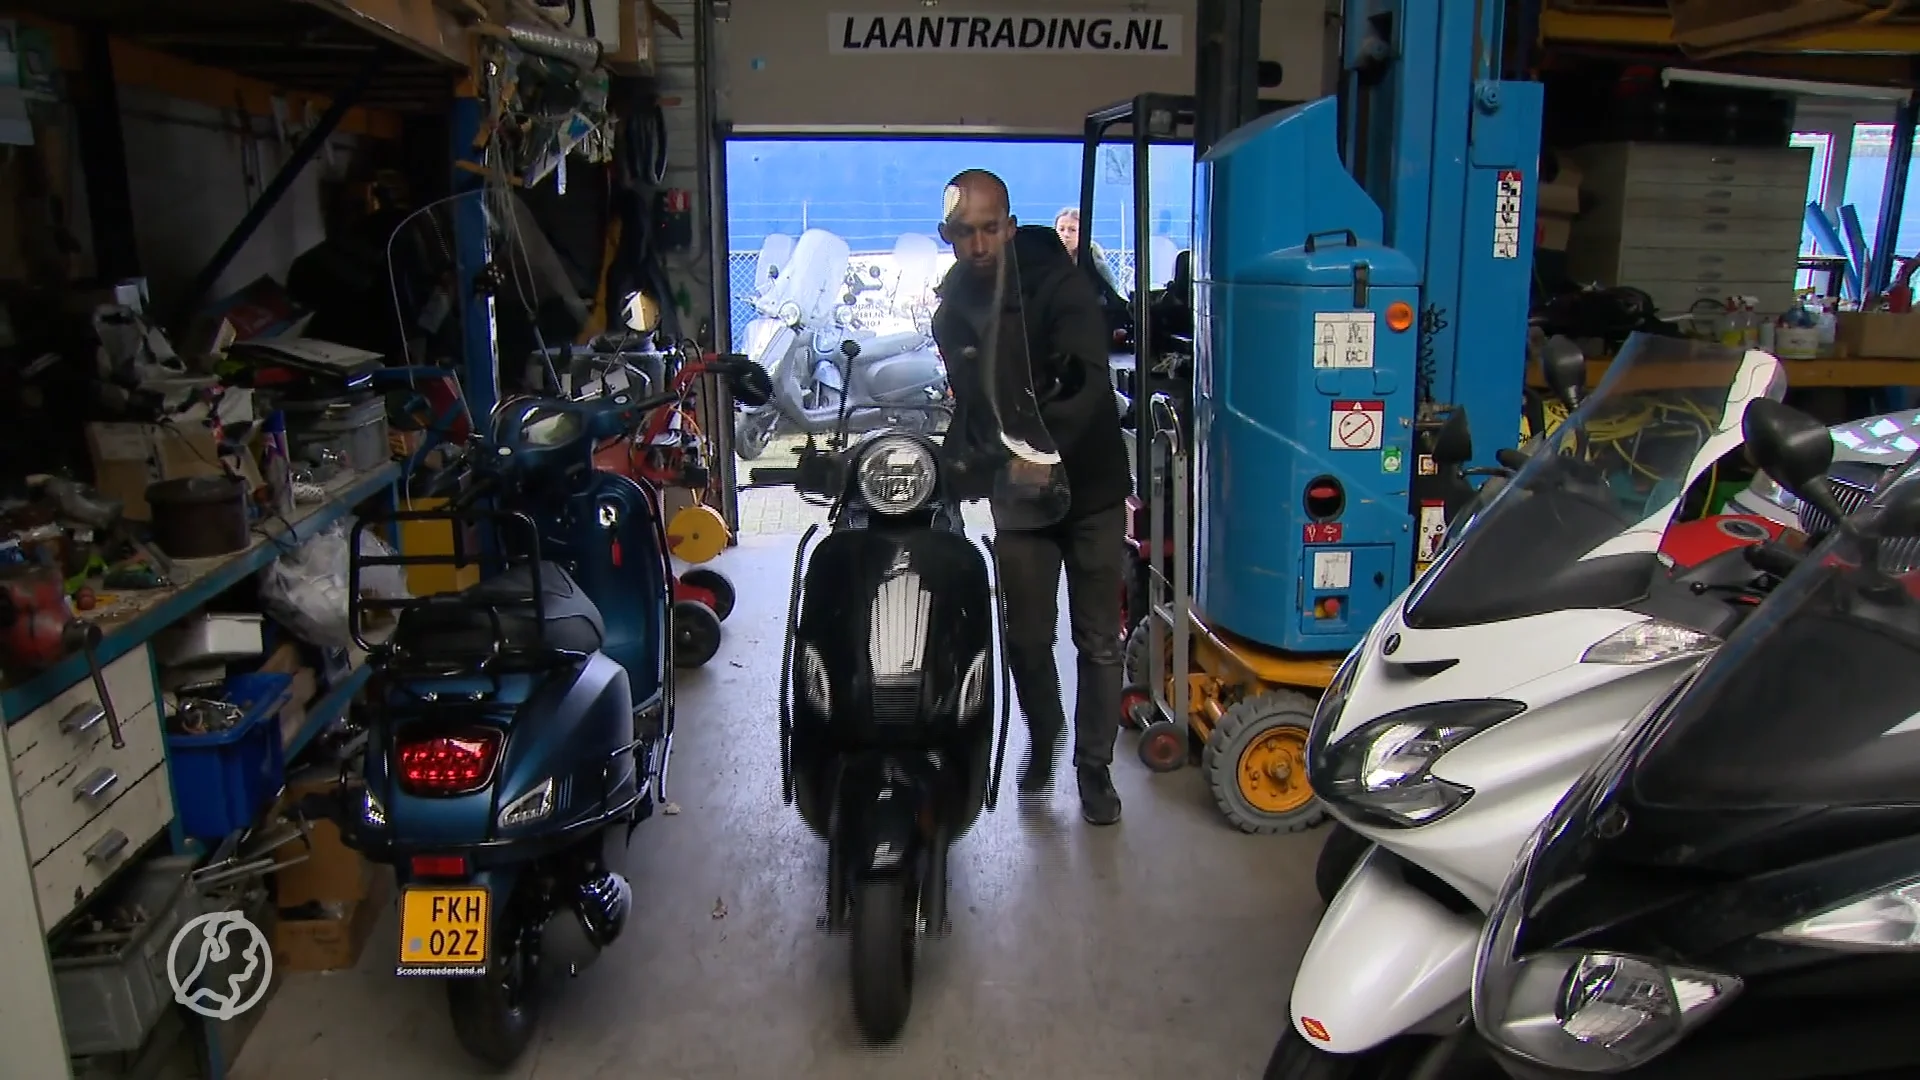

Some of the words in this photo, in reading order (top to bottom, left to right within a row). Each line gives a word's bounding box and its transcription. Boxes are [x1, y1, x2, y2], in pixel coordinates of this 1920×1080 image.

[843, 16, 1169, 50] LAANTRADING.NL
[432, 896, 480, 923] FKH
[396, 966, 486, 976] Scooternederland.nl
